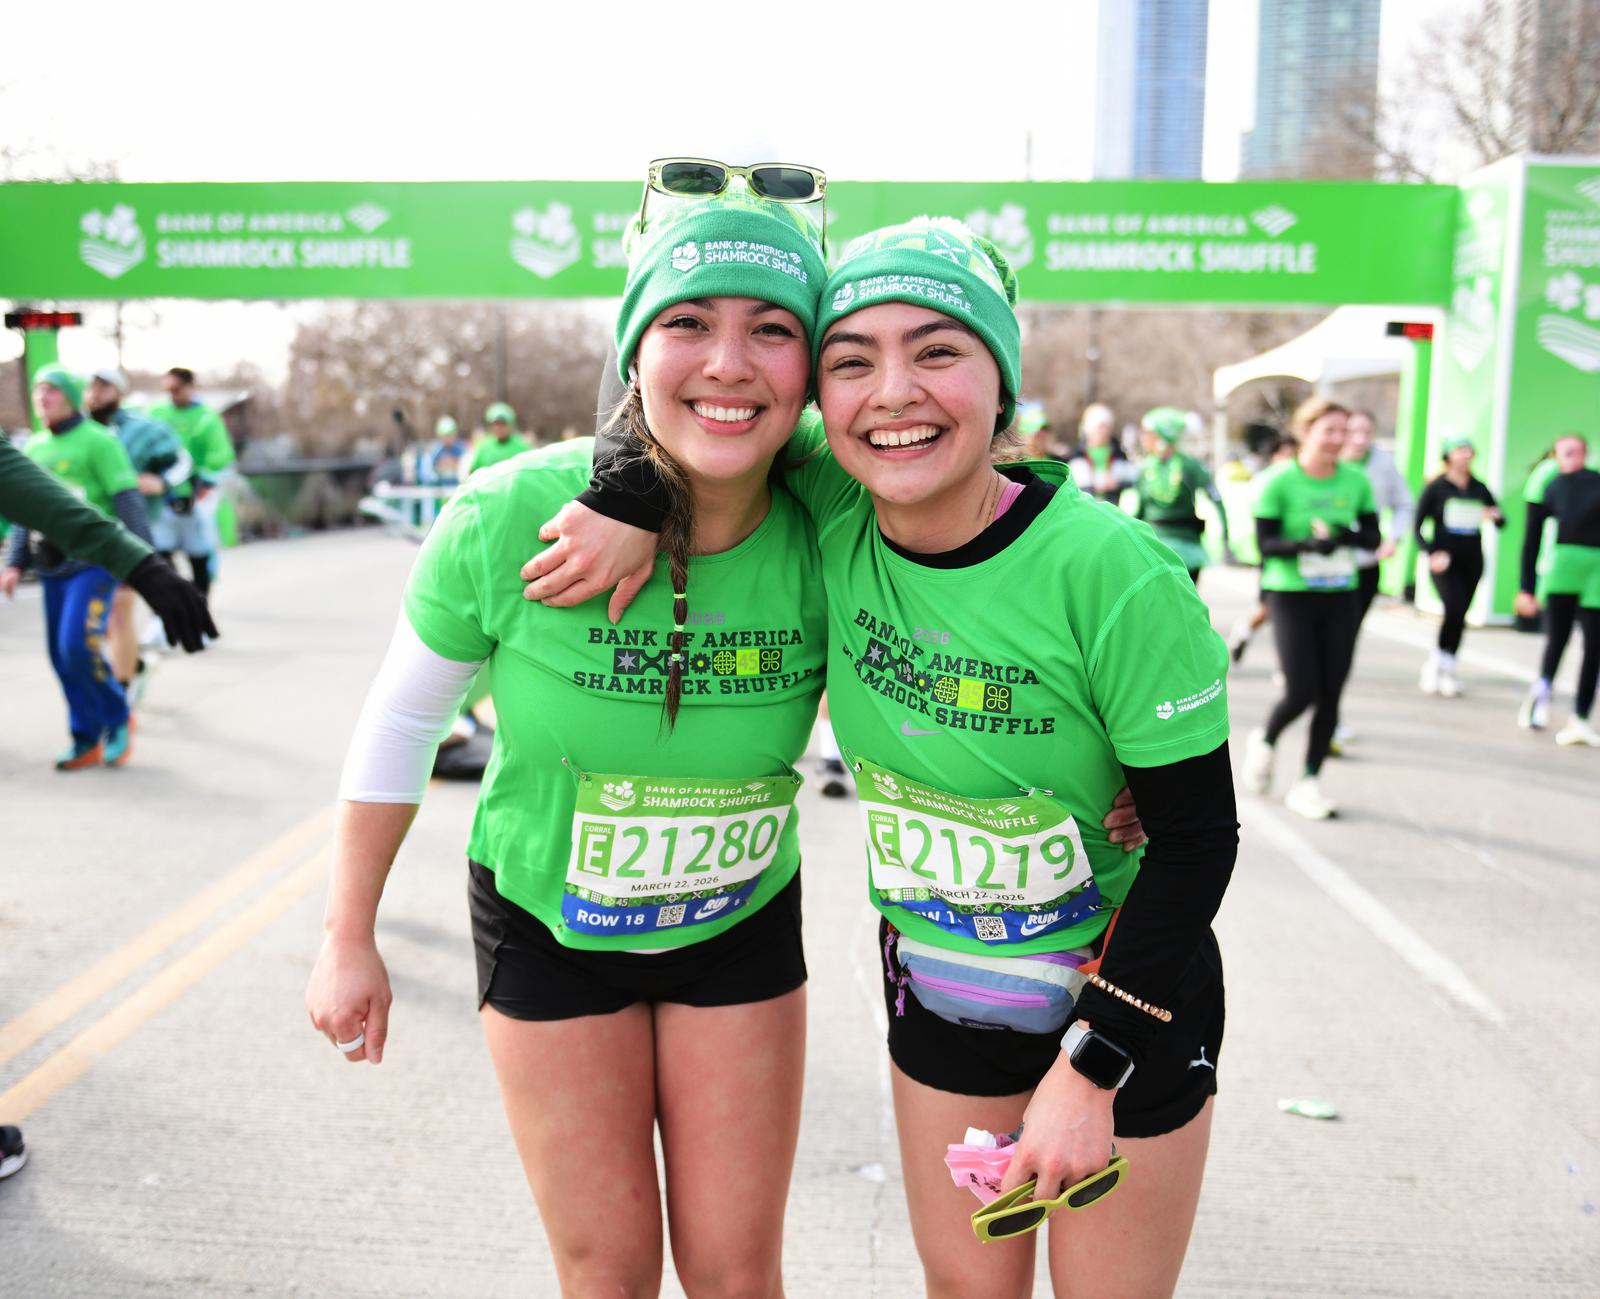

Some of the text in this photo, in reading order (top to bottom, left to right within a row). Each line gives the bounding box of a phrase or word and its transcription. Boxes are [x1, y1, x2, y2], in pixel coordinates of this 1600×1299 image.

[157, 213, 343, 233] BANK OF AMERICA
[1048, 214, 1246, 235] BANK OF AMERICA
[157, 238, 411, 268] SHAMROCK SHUFFLE
[705, 241, 788, 260] BANK OF AMERICA
[1047, 241, 1317, 272] SHAMROCK SHUFFLE
[704, 251, 807, 284] SHAMROCK SHUFFLE
[860, 276, 885, 288] BANK
[904, 275, 946, 290] AMERICA
[859, 283, 971, 313] SHAMROCK SHUFFLE
[684, 610, 724, 625] 026
[588, 628, 658, 646] BANK
[701, 629, 803, 648] AMERICA
[738, 652, 757, 671] 45
[927, 653, 1040, 685] AMERICA
[573, 671, 712, 695] SHAMRCK
[935, 707, 1055, 735] SHUFFLE
[643, 792, 771, 808] SHAMROCK SHUFFLE
[645, 785, 742, 795] BANK OF AMERICA
[905, 785, 995, 816] BANK OF AMERICA
[871, 813, 896, 824] CORRAL
[909, 795, 1039, 830] SHAMROCK SHUFFLE
[584, 825, 612, 834] CORRAL
[583, 834, 607, 874] E
[616, 814, 779, 878] 21280
[876, 824, 904, 867] E
[905, 819, 1075, 890] 21279
[631, 876, 719, 892] MARCH 22, 2026
[616, 898, 628, 907] 45
[577, 909, 645, 927] ROW 18
[1026, 911, 1059, 925] RUN
